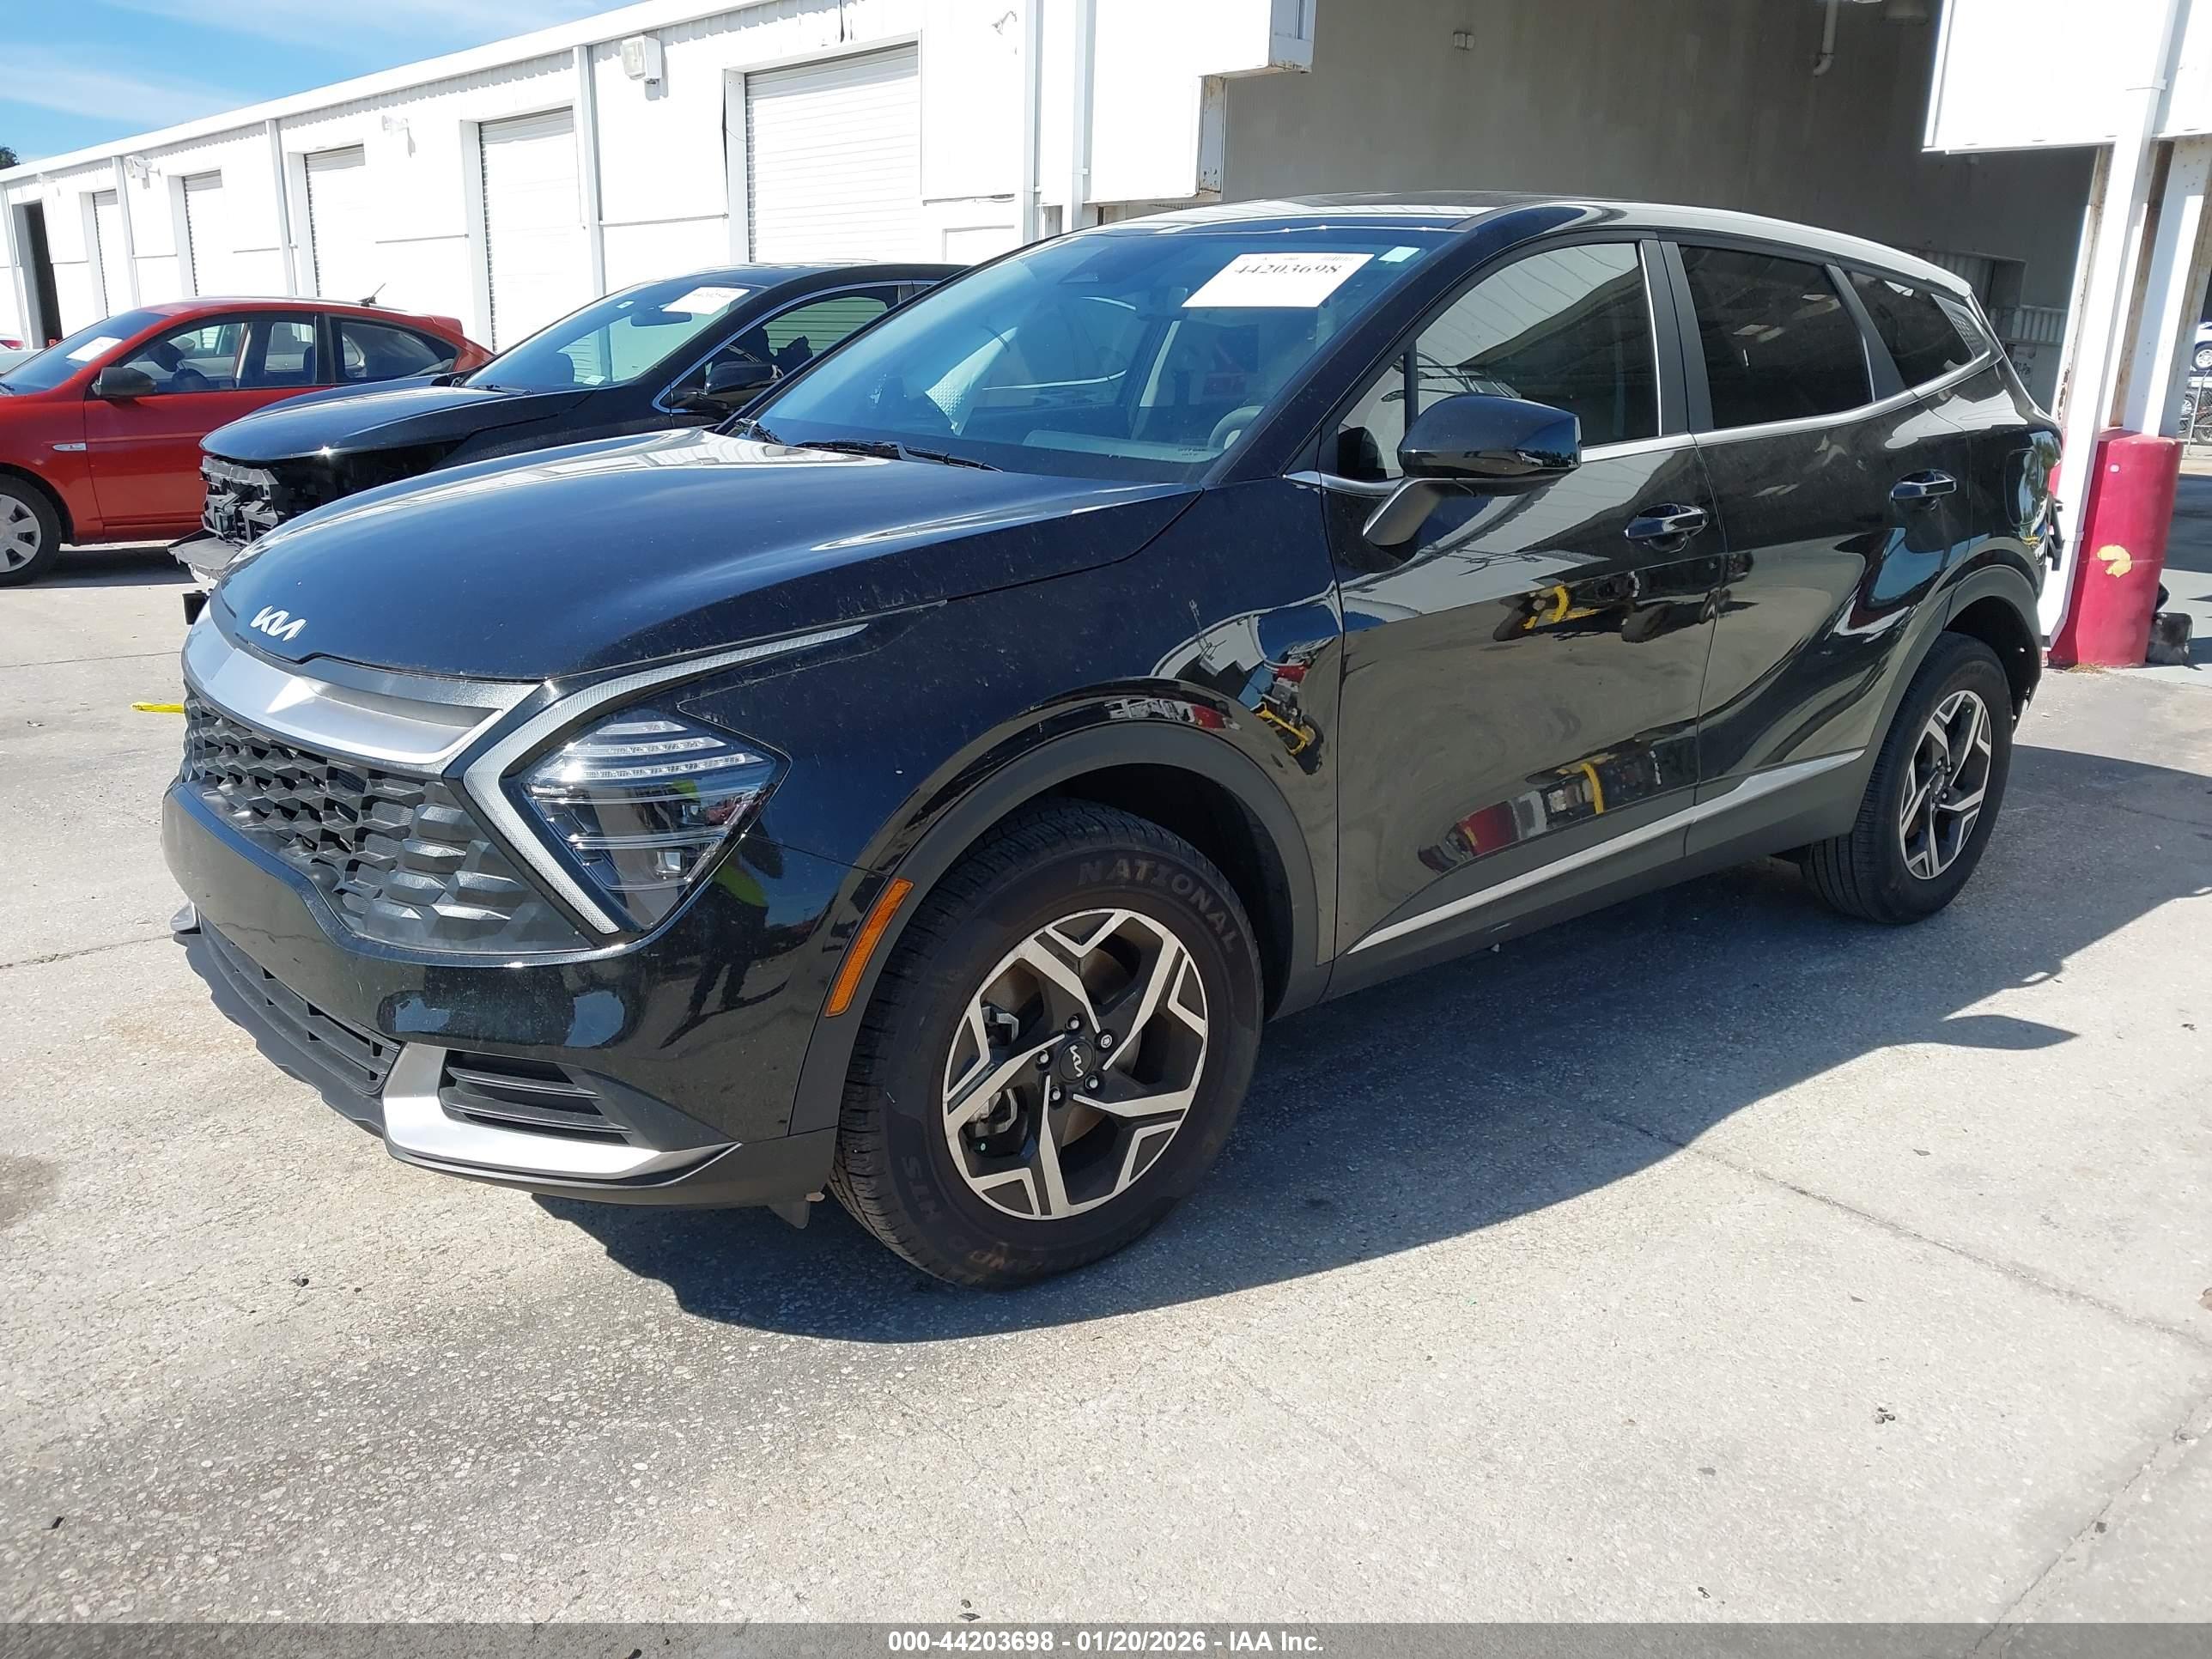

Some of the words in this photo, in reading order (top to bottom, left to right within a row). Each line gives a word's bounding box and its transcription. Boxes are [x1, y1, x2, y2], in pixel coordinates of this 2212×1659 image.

[1235, 264, 1342, 275] 44203698
[249, 605, 307, 642] KIA
[1078, 857, 1238, 953] NATIONAL
